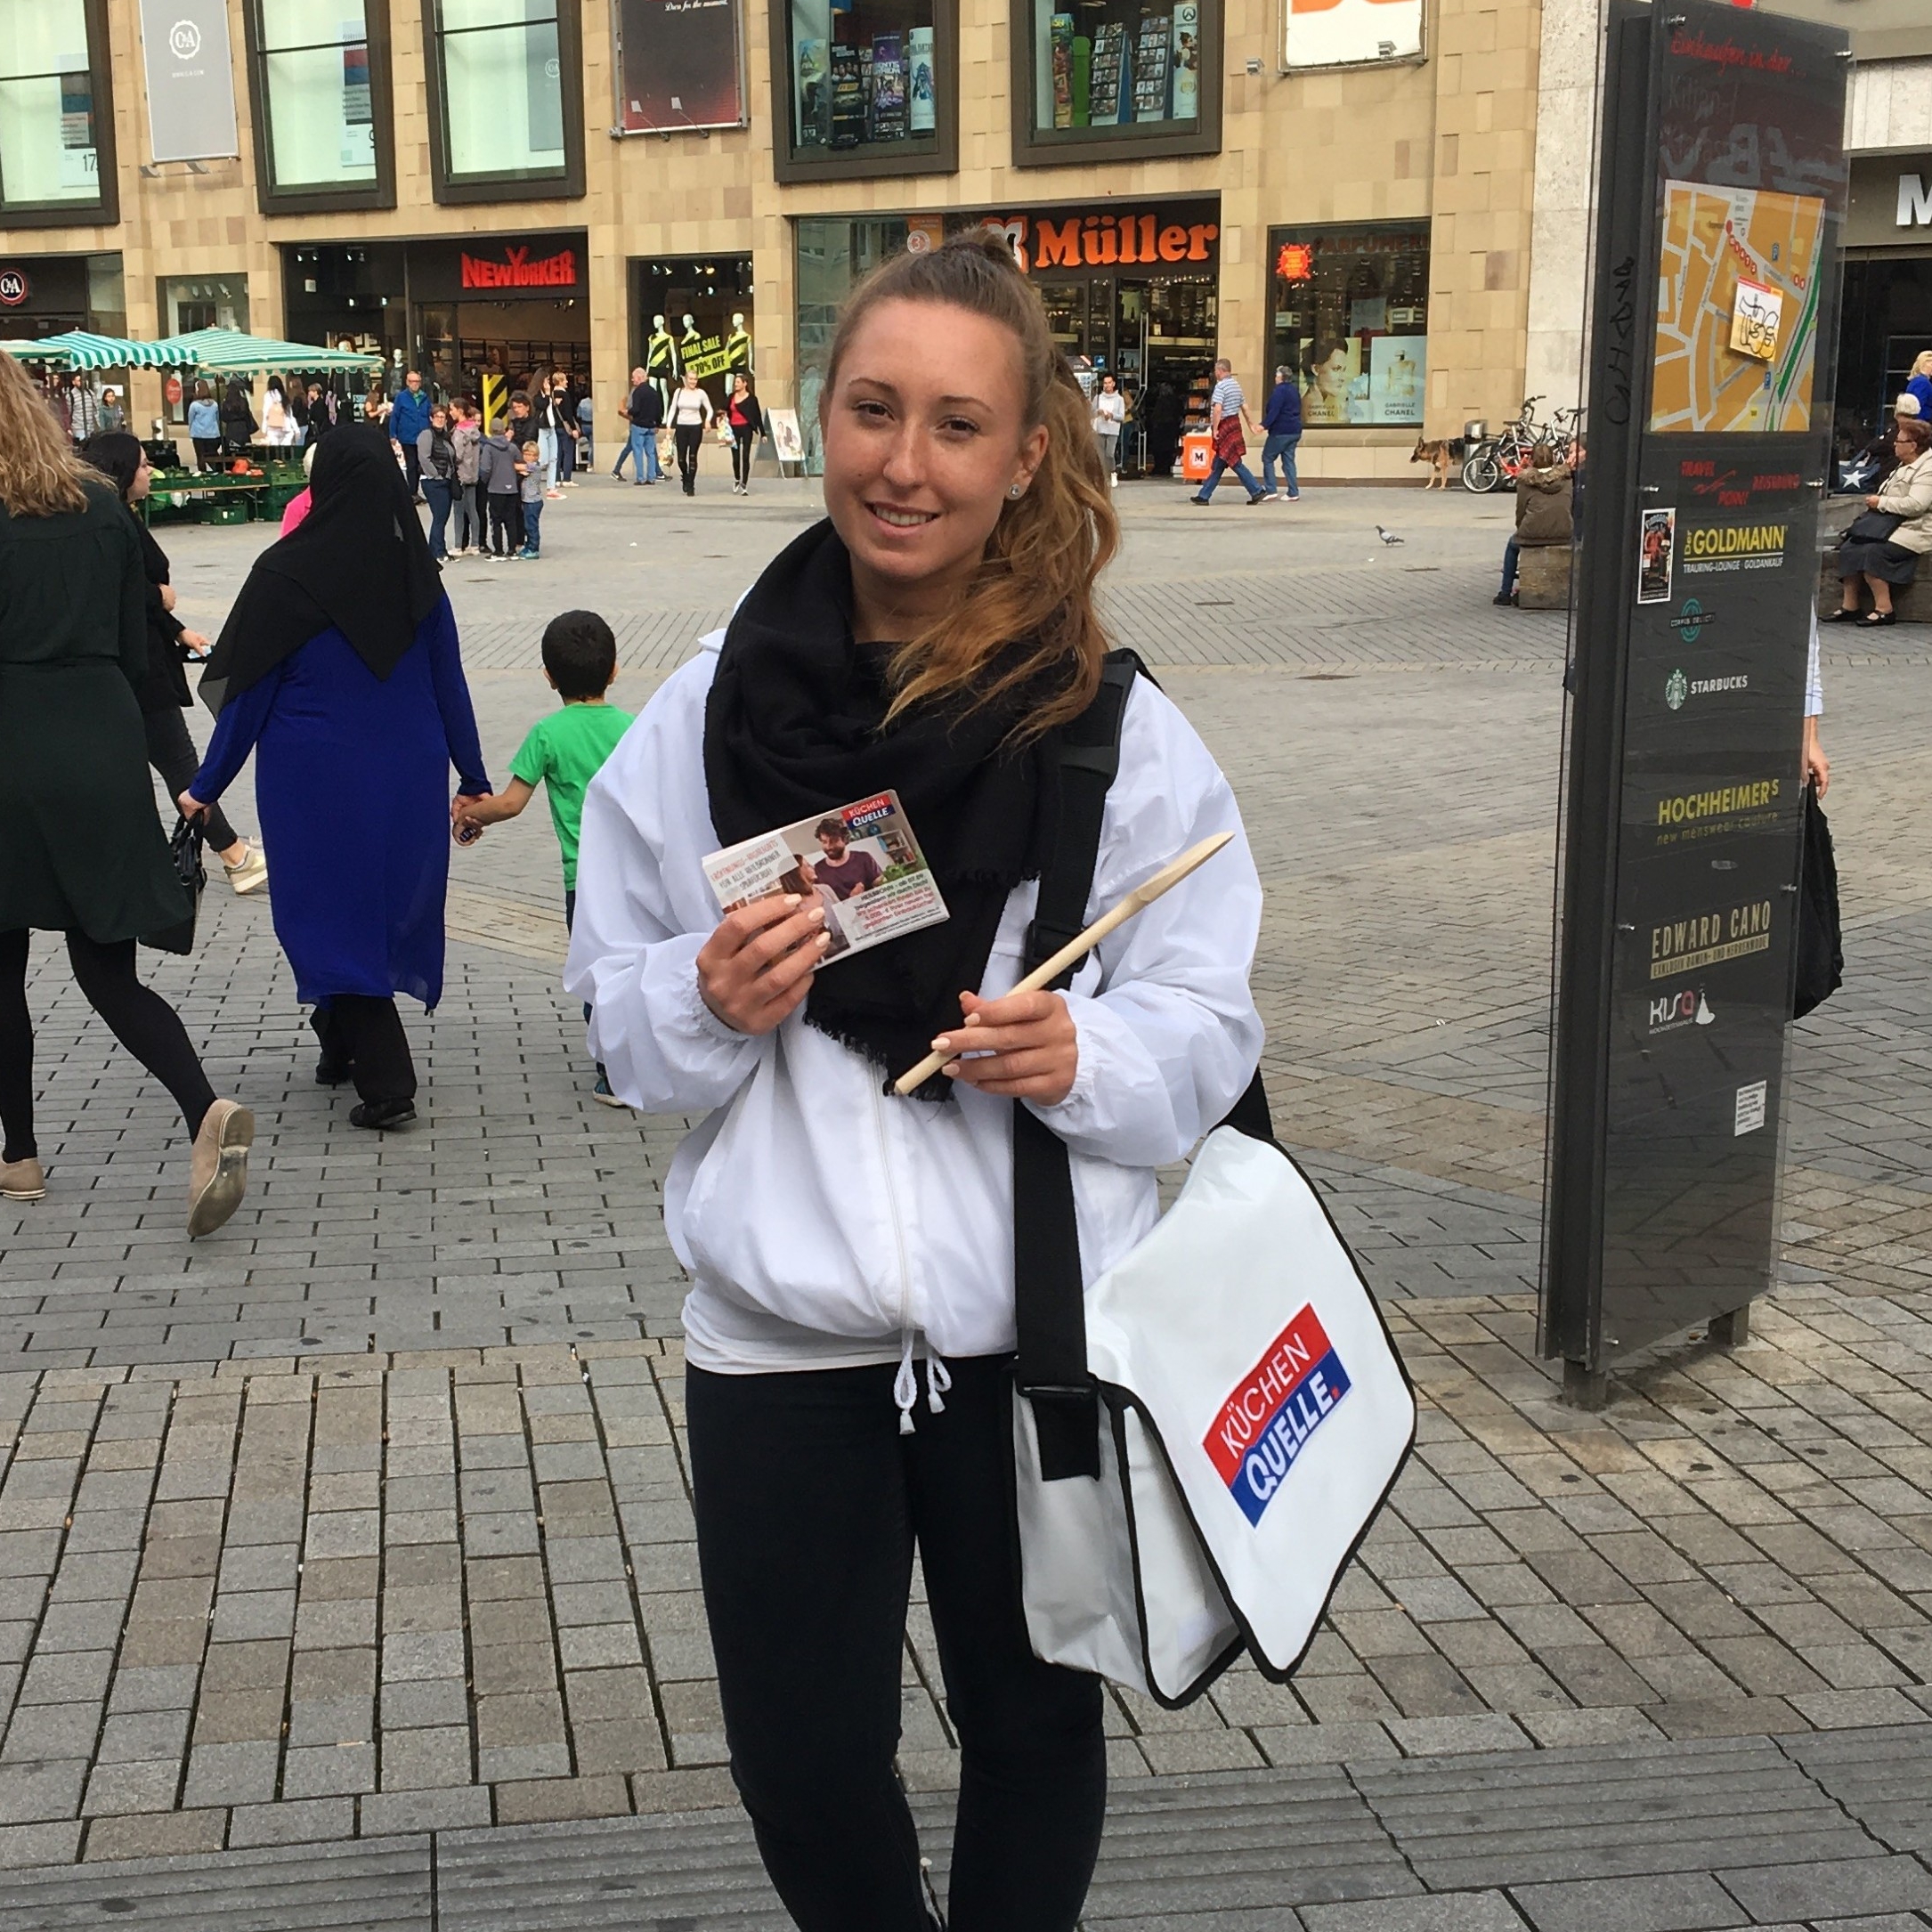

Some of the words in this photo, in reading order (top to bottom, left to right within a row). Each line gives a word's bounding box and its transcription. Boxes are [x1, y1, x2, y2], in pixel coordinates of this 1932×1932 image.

[1035, 215, 1219, 268] Müller
[1, 278, 20, 294] C&A
[681, 342, 702, 360] FINAL
[702, 336, 721, 352] SALE
[712, 354, 725, 369] OFF
[1693, 525, 1785, 555] GOLDMANN
[1684, 560, 1741, 573] TRAURING-LOUNGE
[1743, 557, 1783, 570] GOLDANKAUF
[1691, 674, 1748, 694] STARBUCKS
[848, 799, 885, 817] KÜCHEN
[1658, 778, 1780, 825] HOCHHEIMERS
[1657, 833, 1678, 846] new
[1652, 913, 1721, 959] EDWARD
[1730, 900, 1771, 938] CANO
[1220, 1332, 1311, 1459] KÜCHEN
